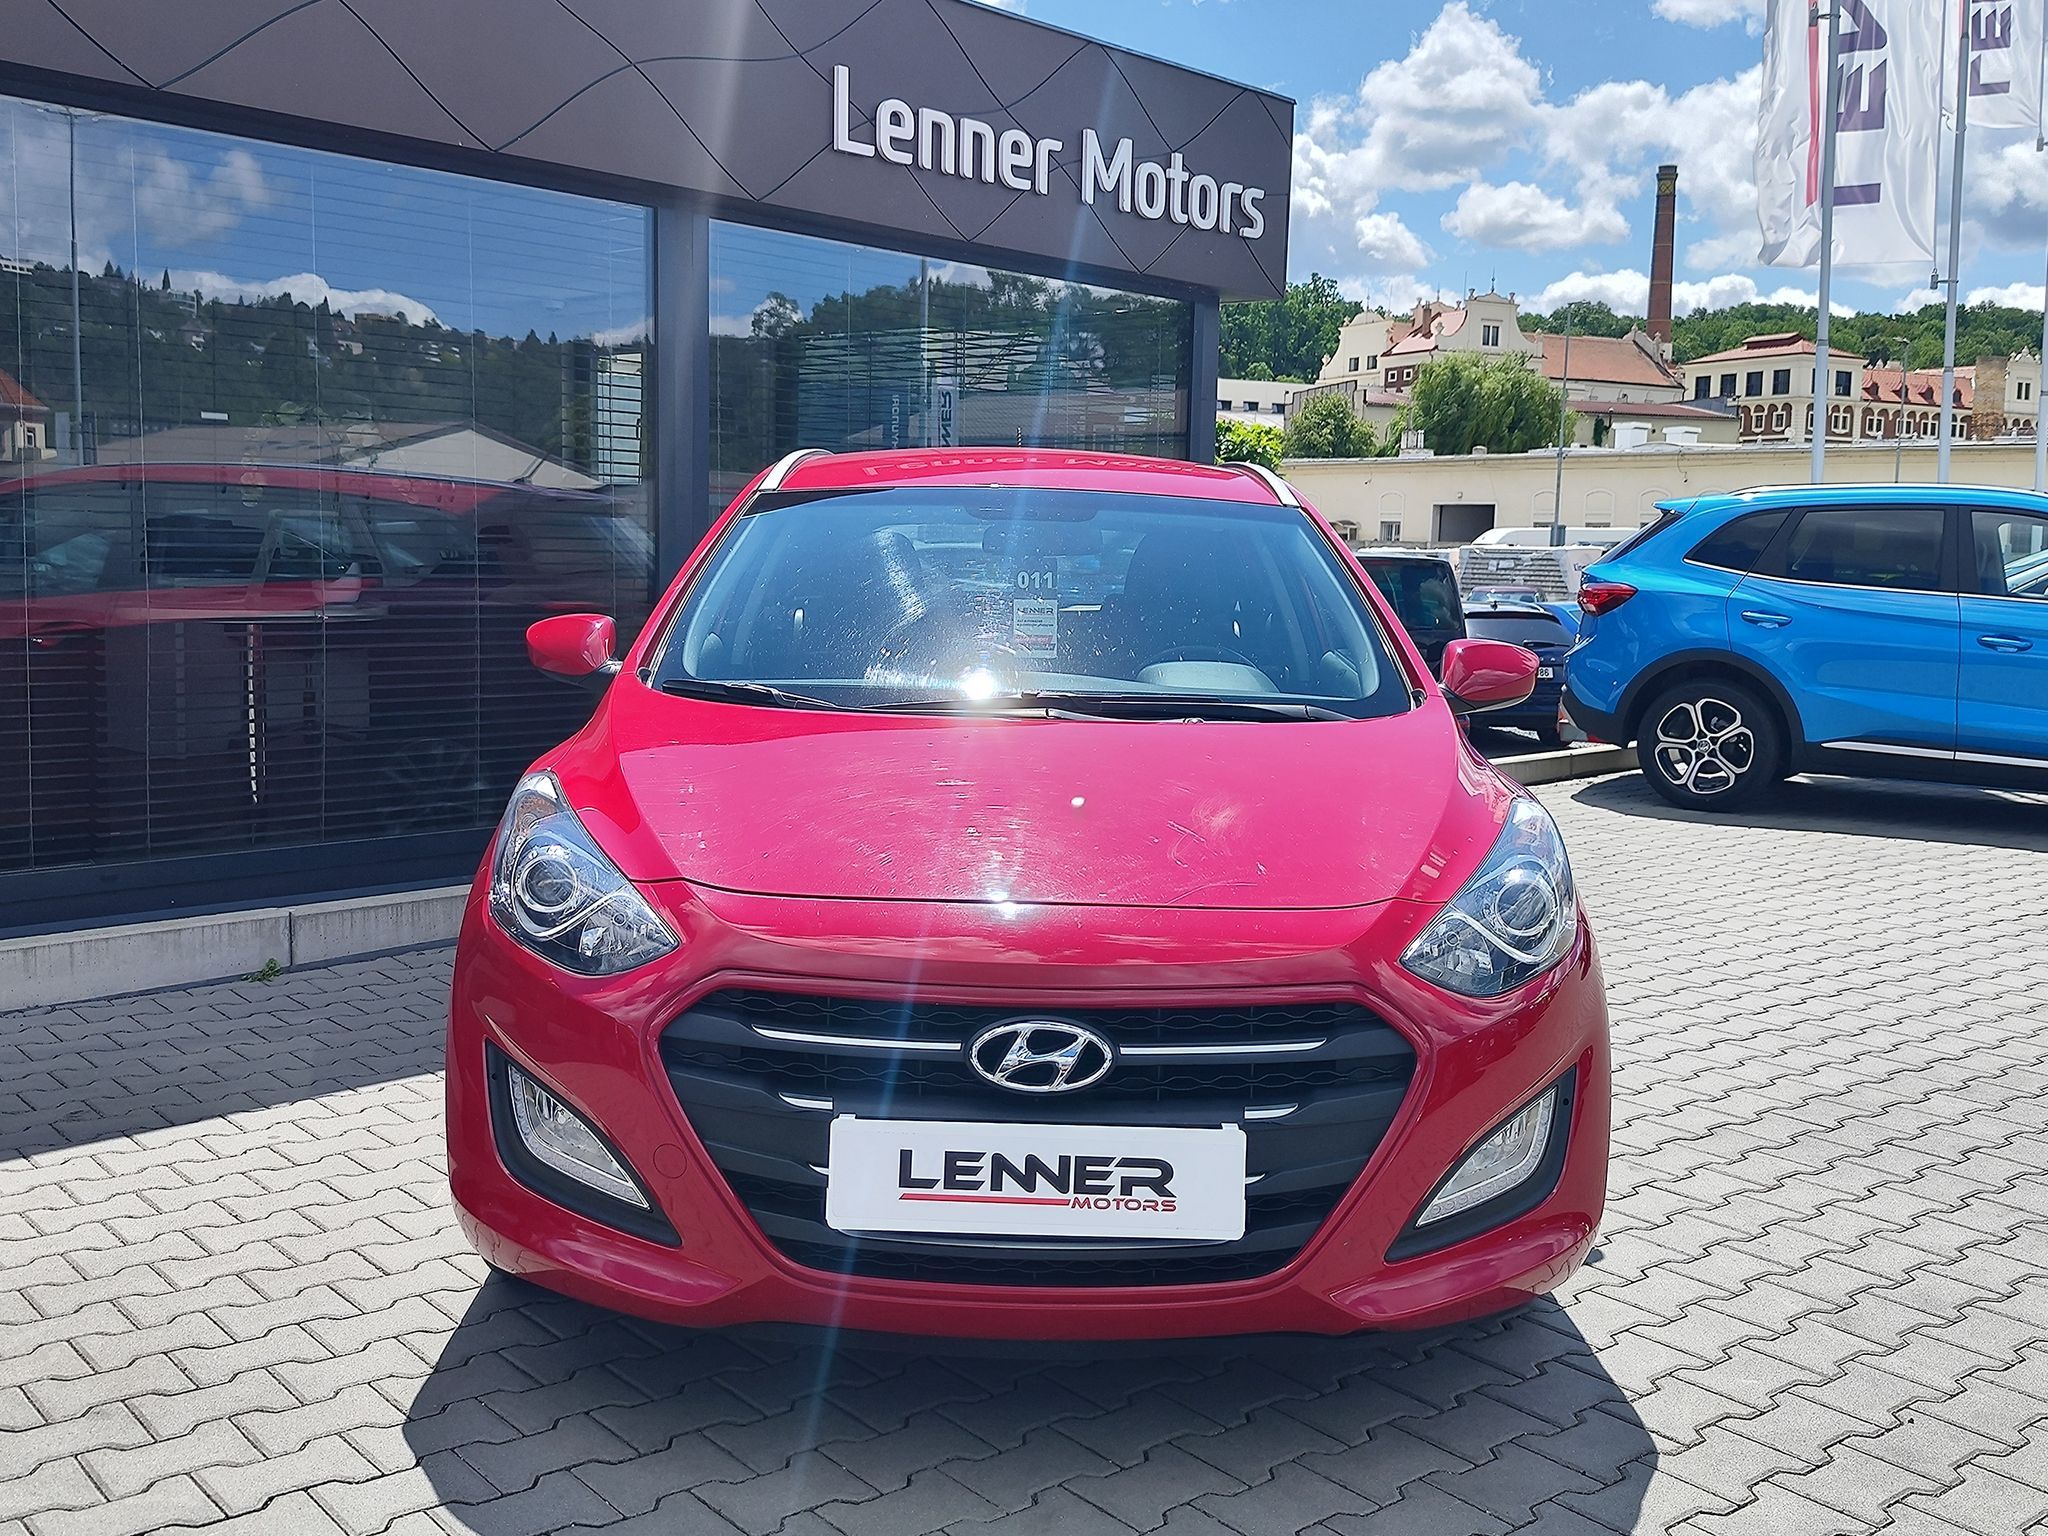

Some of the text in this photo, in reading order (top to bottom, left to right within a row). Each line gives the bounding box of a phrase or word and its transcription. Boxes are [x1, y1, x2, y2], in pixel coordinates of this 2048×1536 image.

[1969, 0, 2011, 96] LE
[832, 64, 1266, 240] Lenner Motors
[1017, 571, 1053, 589] 011
[898, 1148, 1177, 1198] LENNER
[1071, 1197, 1177, 1212] MOTORS
